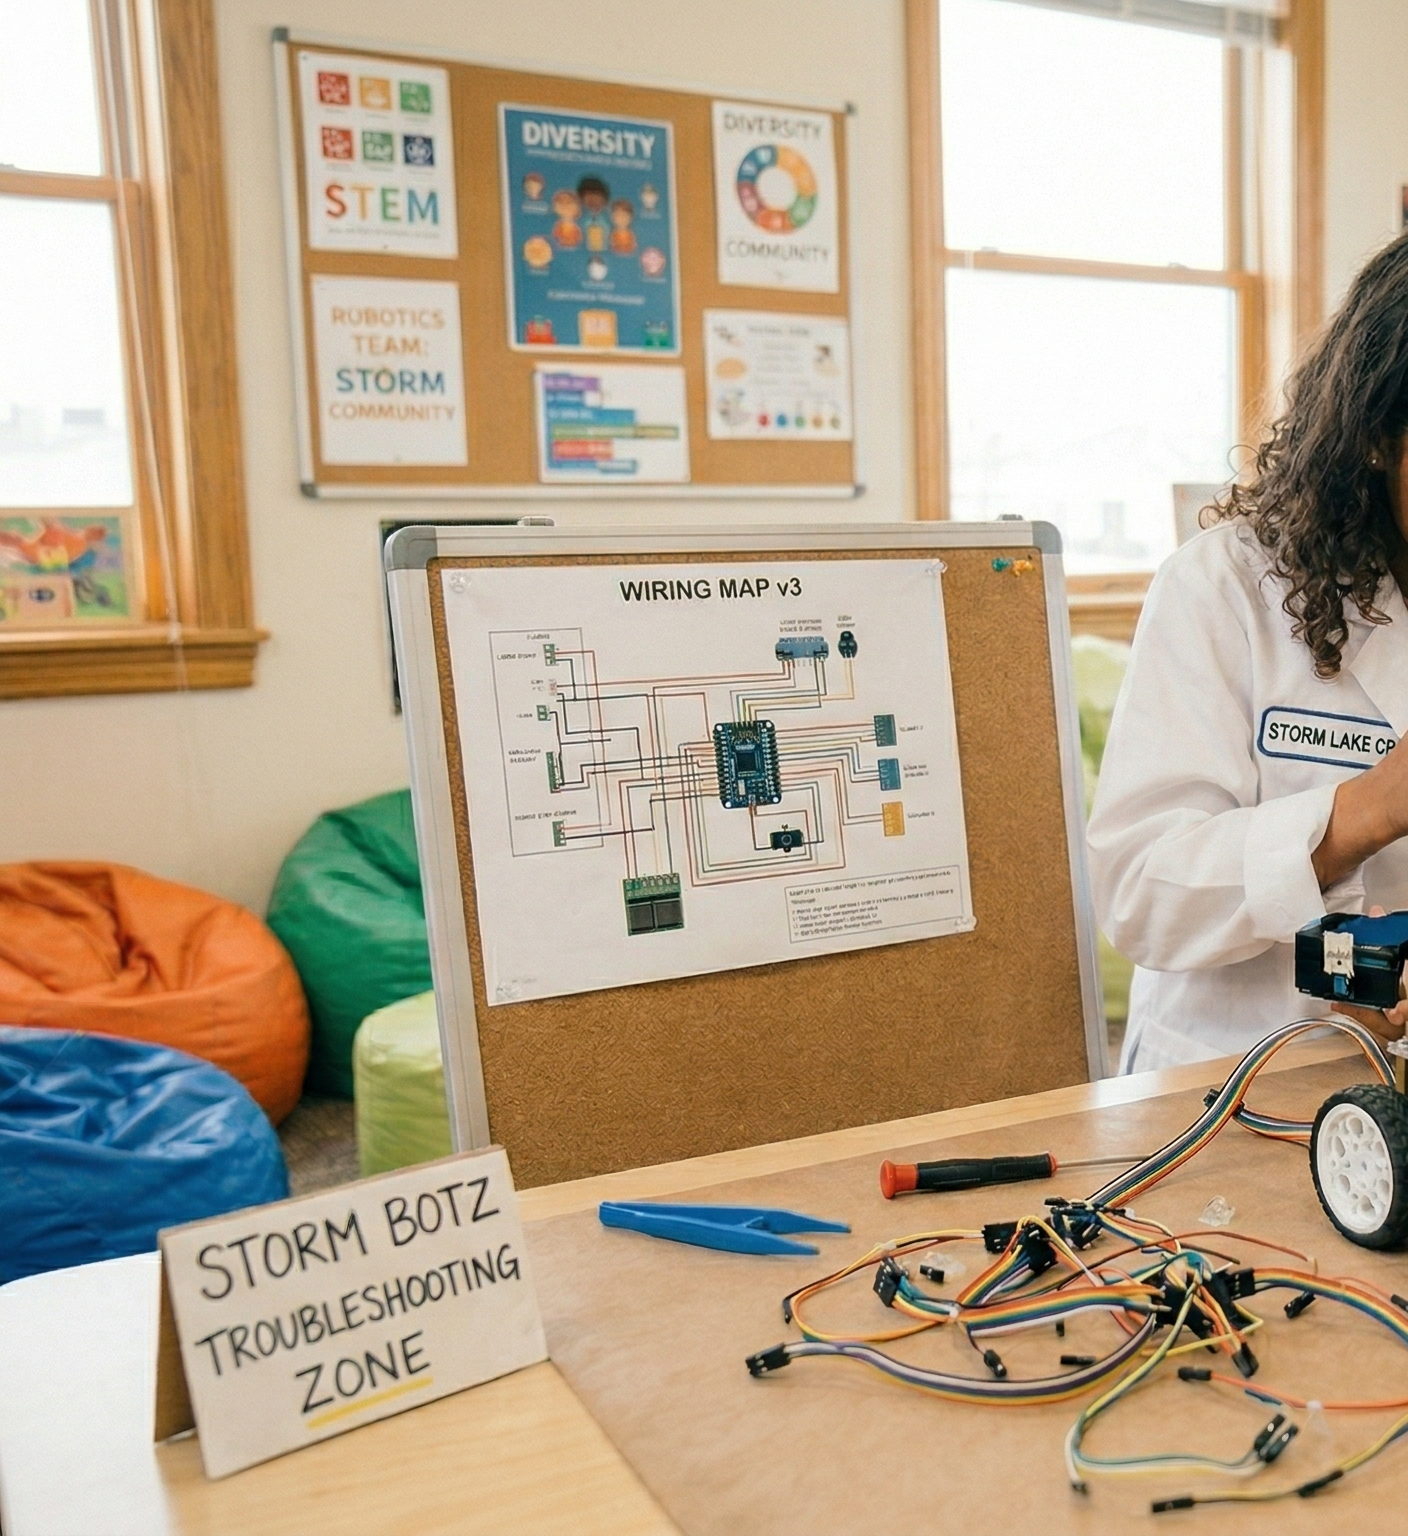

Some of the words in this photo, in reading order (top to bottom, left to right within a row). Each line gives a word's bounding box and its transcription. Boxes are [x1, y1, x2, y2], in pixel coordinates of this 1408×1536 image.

[522, 120, 655, 158] DIVERSITY
[723, 112, 823, 141] DIVERSITY
[325, 183, 440, 225] STEM
[727, 239, 831, 264] COMMUNITY
[331, 306, 445, 330] ROBOTICS
[352, 333, 429, 357] TEAM:
[336, 367, 446, 395] STORM
[329, 401, 456, 421] COMMUNITY
[620, 579, 711, 601] WIRING
[719, 577, 770, 599] MAP
[777, 577, 803, 597] v3
[1268, 722, 1327, 746] STORM
[1330, 730, 1372, 753] LAKE
[198, 1212, 367, 1299] STORM
[384, 1177, 499, 1246] BOTZ
[195, 1244, 520, 1375] TROUBLESHOOTING
[296, 1332, 430, 1413] ZONE
